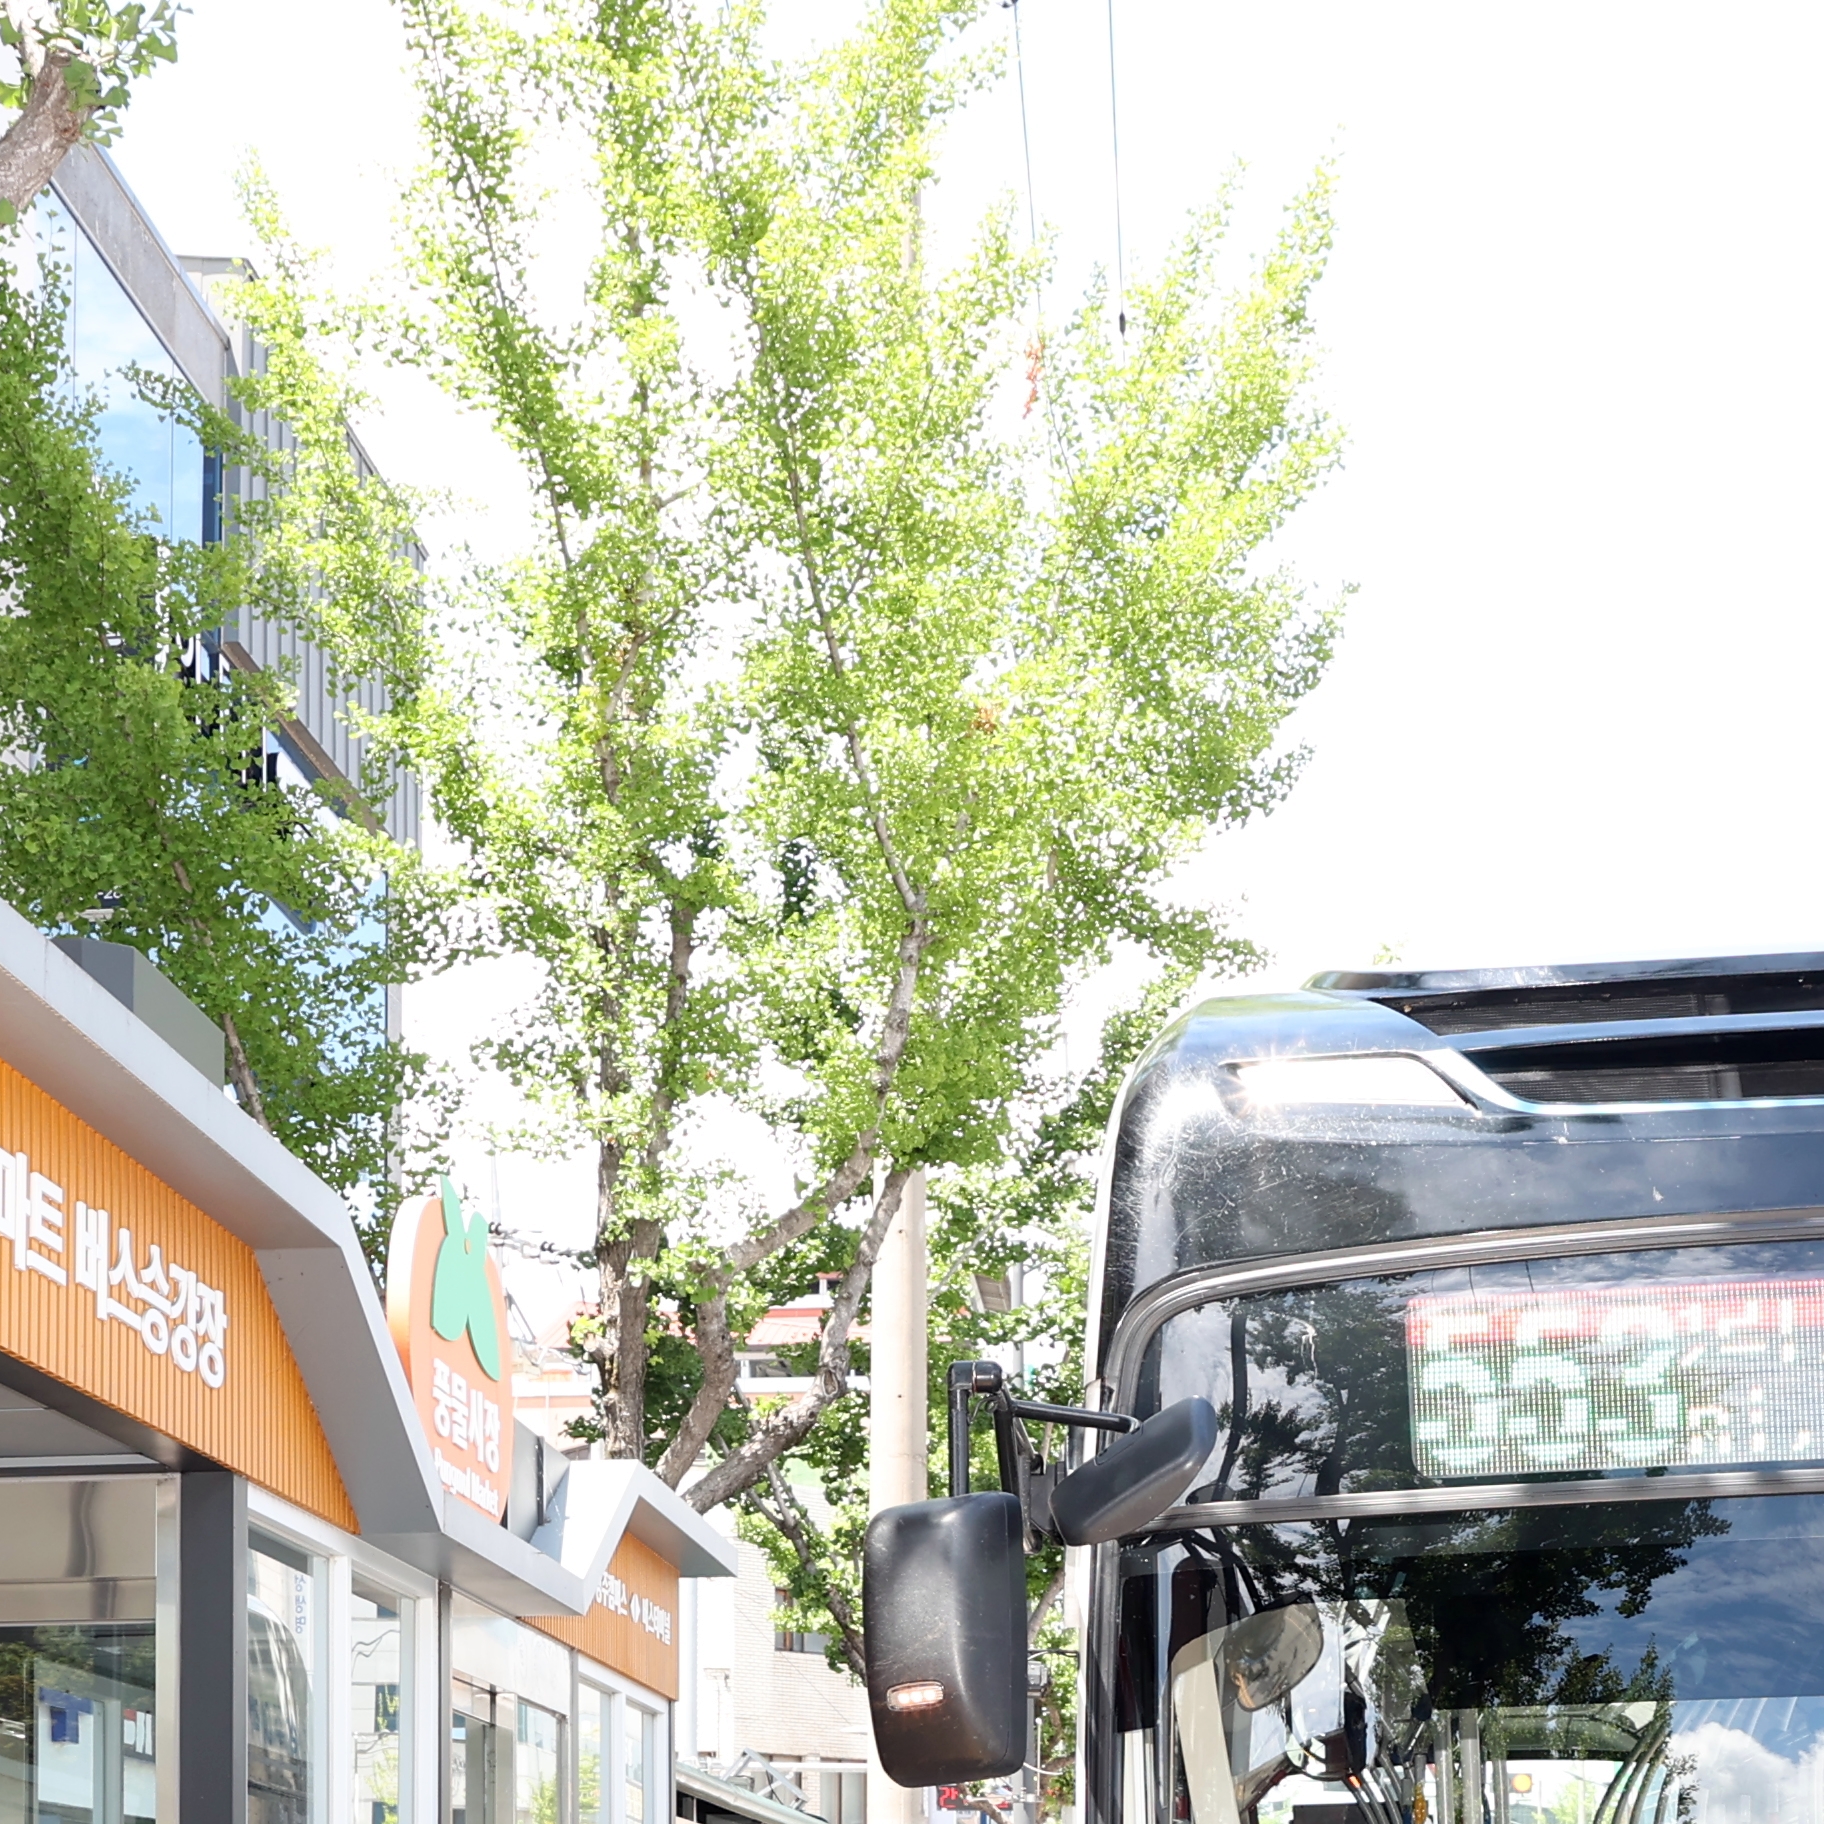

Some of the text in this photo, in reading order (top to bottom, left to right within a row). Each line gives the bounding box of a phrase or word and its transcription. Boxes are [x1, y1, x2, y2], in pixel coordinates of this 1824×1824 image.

[76, 1201, 228, 1390] 버스승강장
[432, 1357, 501, 1474] 풍물시장
[471, 1471, 500, 1517] Market
[642, 1598, 671, 1646] 버스터미널
